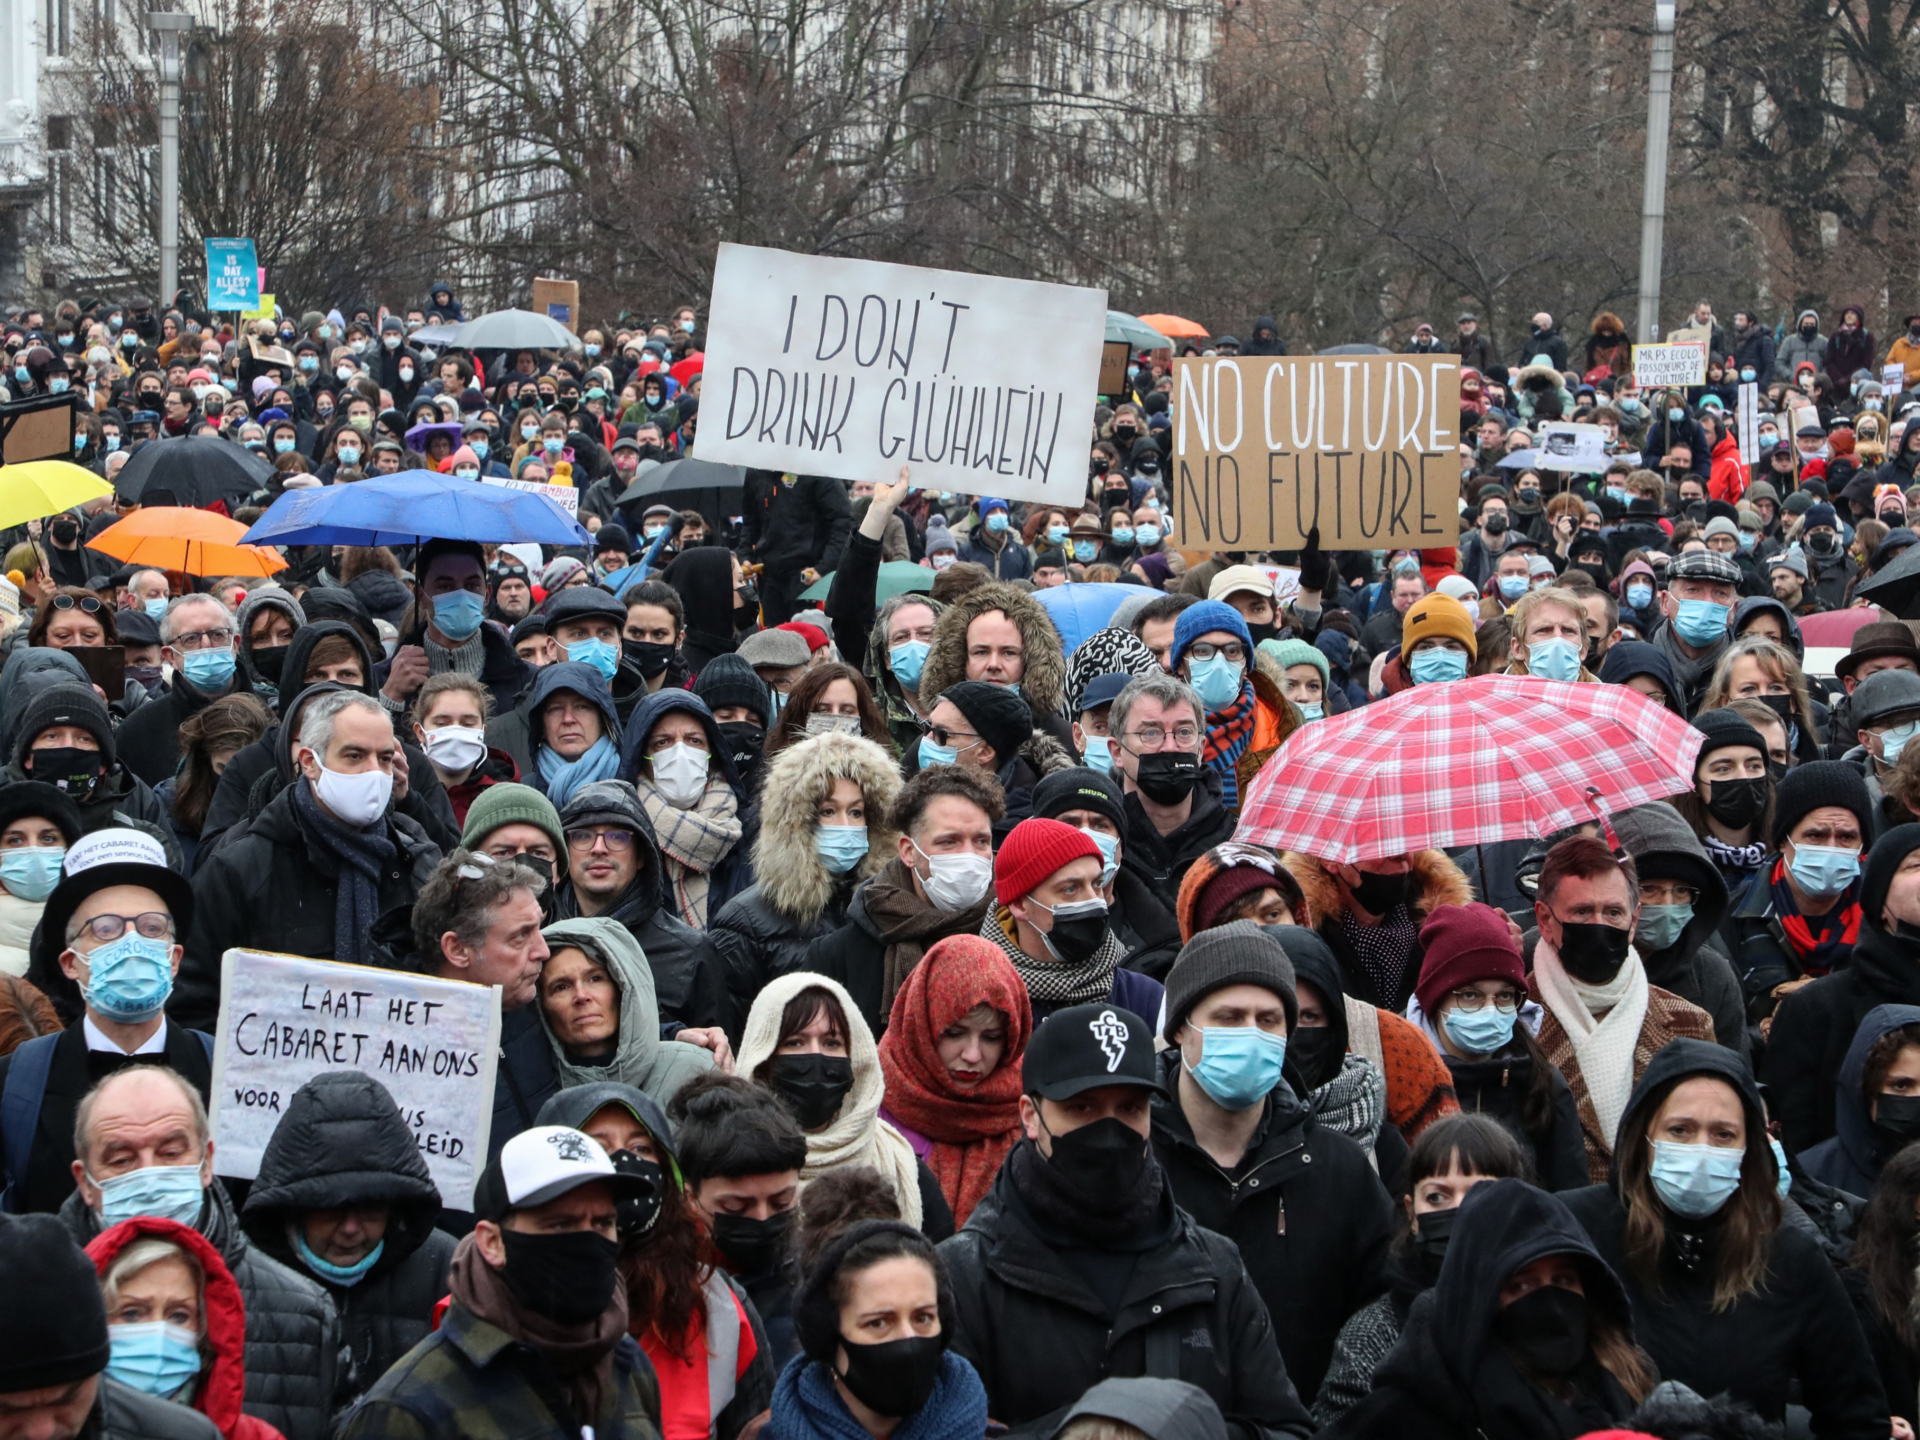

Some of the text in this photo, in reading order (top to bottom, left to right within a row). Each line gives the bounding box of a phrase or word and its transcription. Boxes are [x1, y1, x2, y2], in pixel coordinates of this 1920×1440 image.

[224, 266, 242, 276] DAT
[227, 255, 237, 266] IS
[216, 276, 250, 288] ALLES?
[783, 292, 970, 376] I DON'T
[1640, 348, 1699, 361] MR PS ECOLO
[1690, 360, 1701, 371] DE
[1640, 375, 1650, 385] LA
[1178, 359, 1456, 455] NO CULTURE
[726, 366, 1063, 484] DRINK GLÜHWEIN
[1180, 451, 1444, 546] NO FUTURE
[84, 844, 99, 855] HET
[101, 840, 138, 850] CABARET
[104, 940, 158, 967] CORON
[302, 983, 444, 1026] LAAT HET
[236, 1012, 479, 1078] CABARET AAN ONS
[234, 1086, 280, 1113] VOOR
